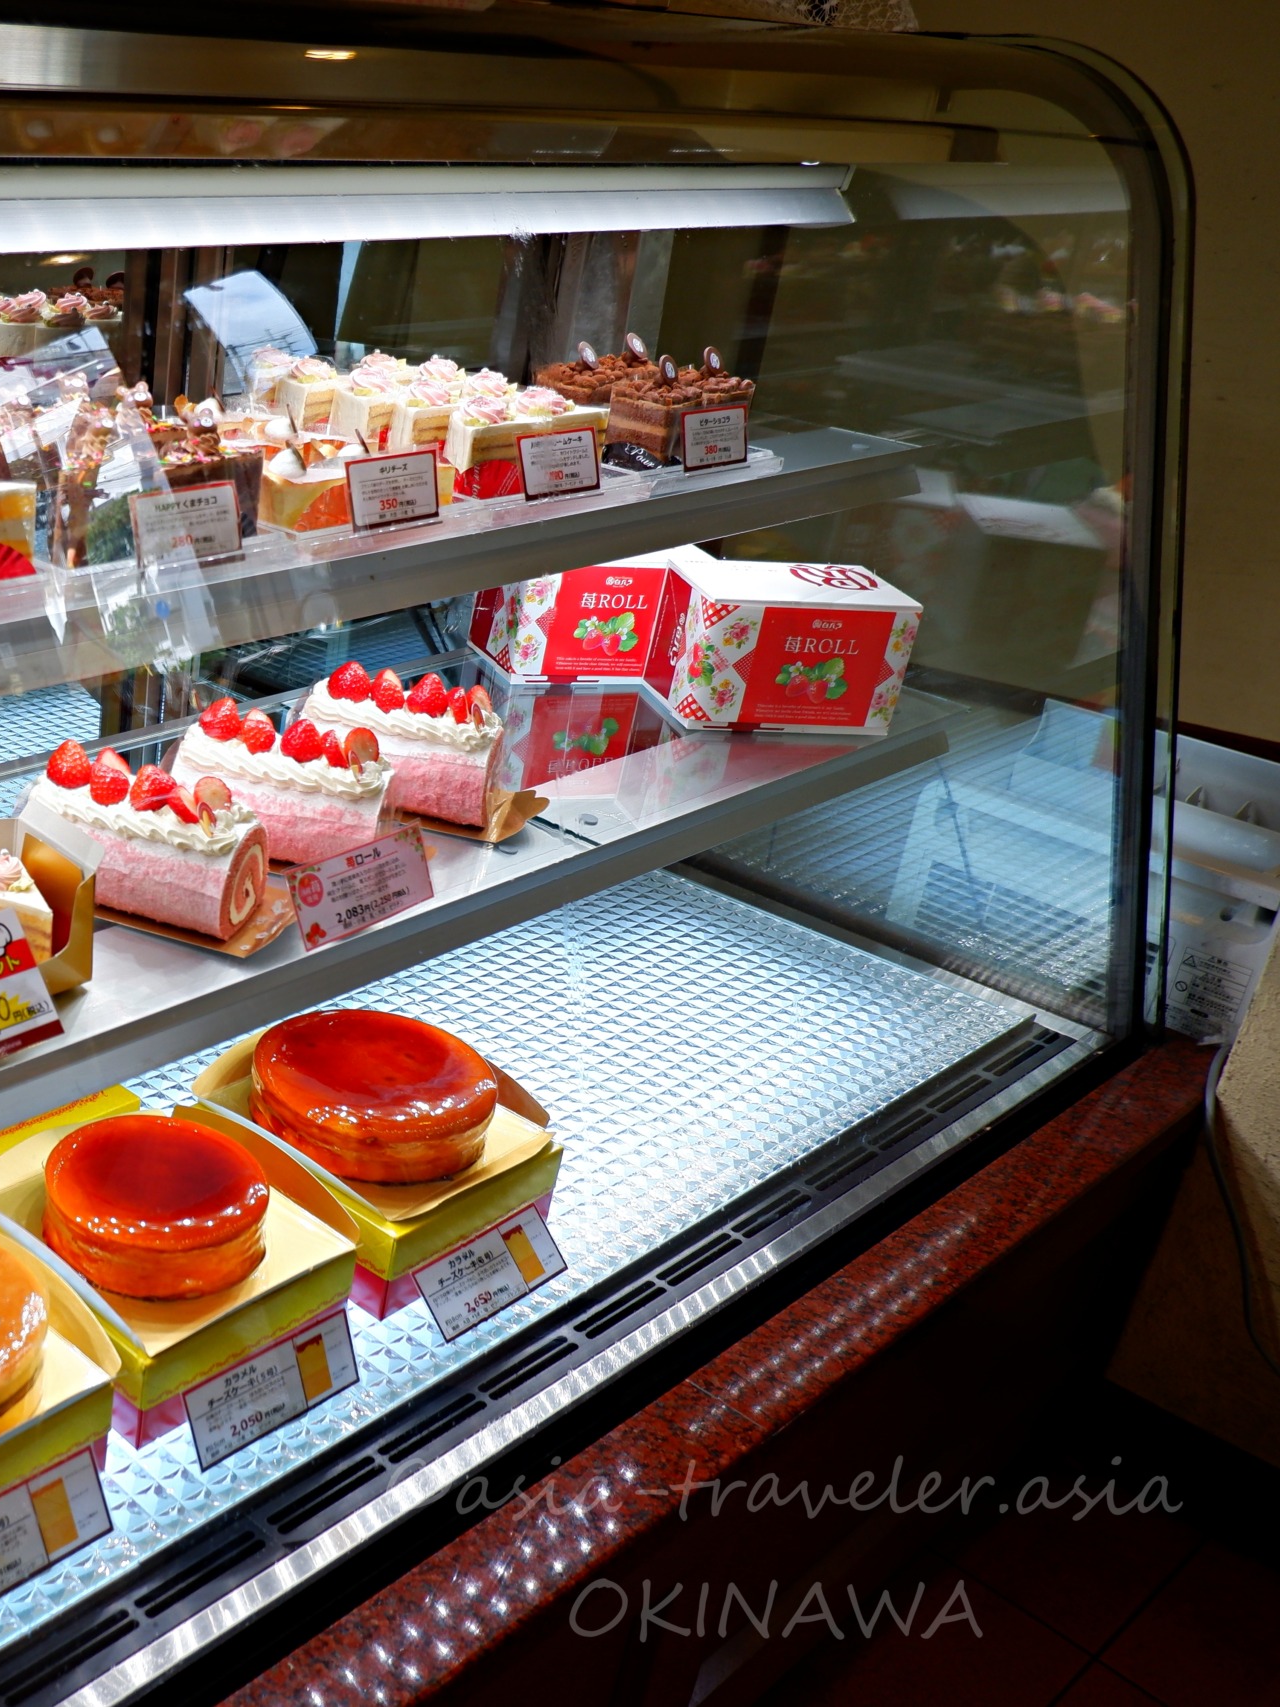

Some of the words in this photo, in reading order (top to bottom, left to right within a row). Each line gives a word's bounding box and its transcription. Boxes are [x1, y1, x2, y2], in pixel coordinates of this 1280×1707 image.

[380, 498, 398, 510] 350
[581, 592, 648, 609] 苺ROLL
[785, 635, 859, 655] 苺ROLL
[345, 847, 381, 869] 苺ロール
[224, 1365, 257, 1387] カラメル
[230, 1410, 264, 1437] 2,050
